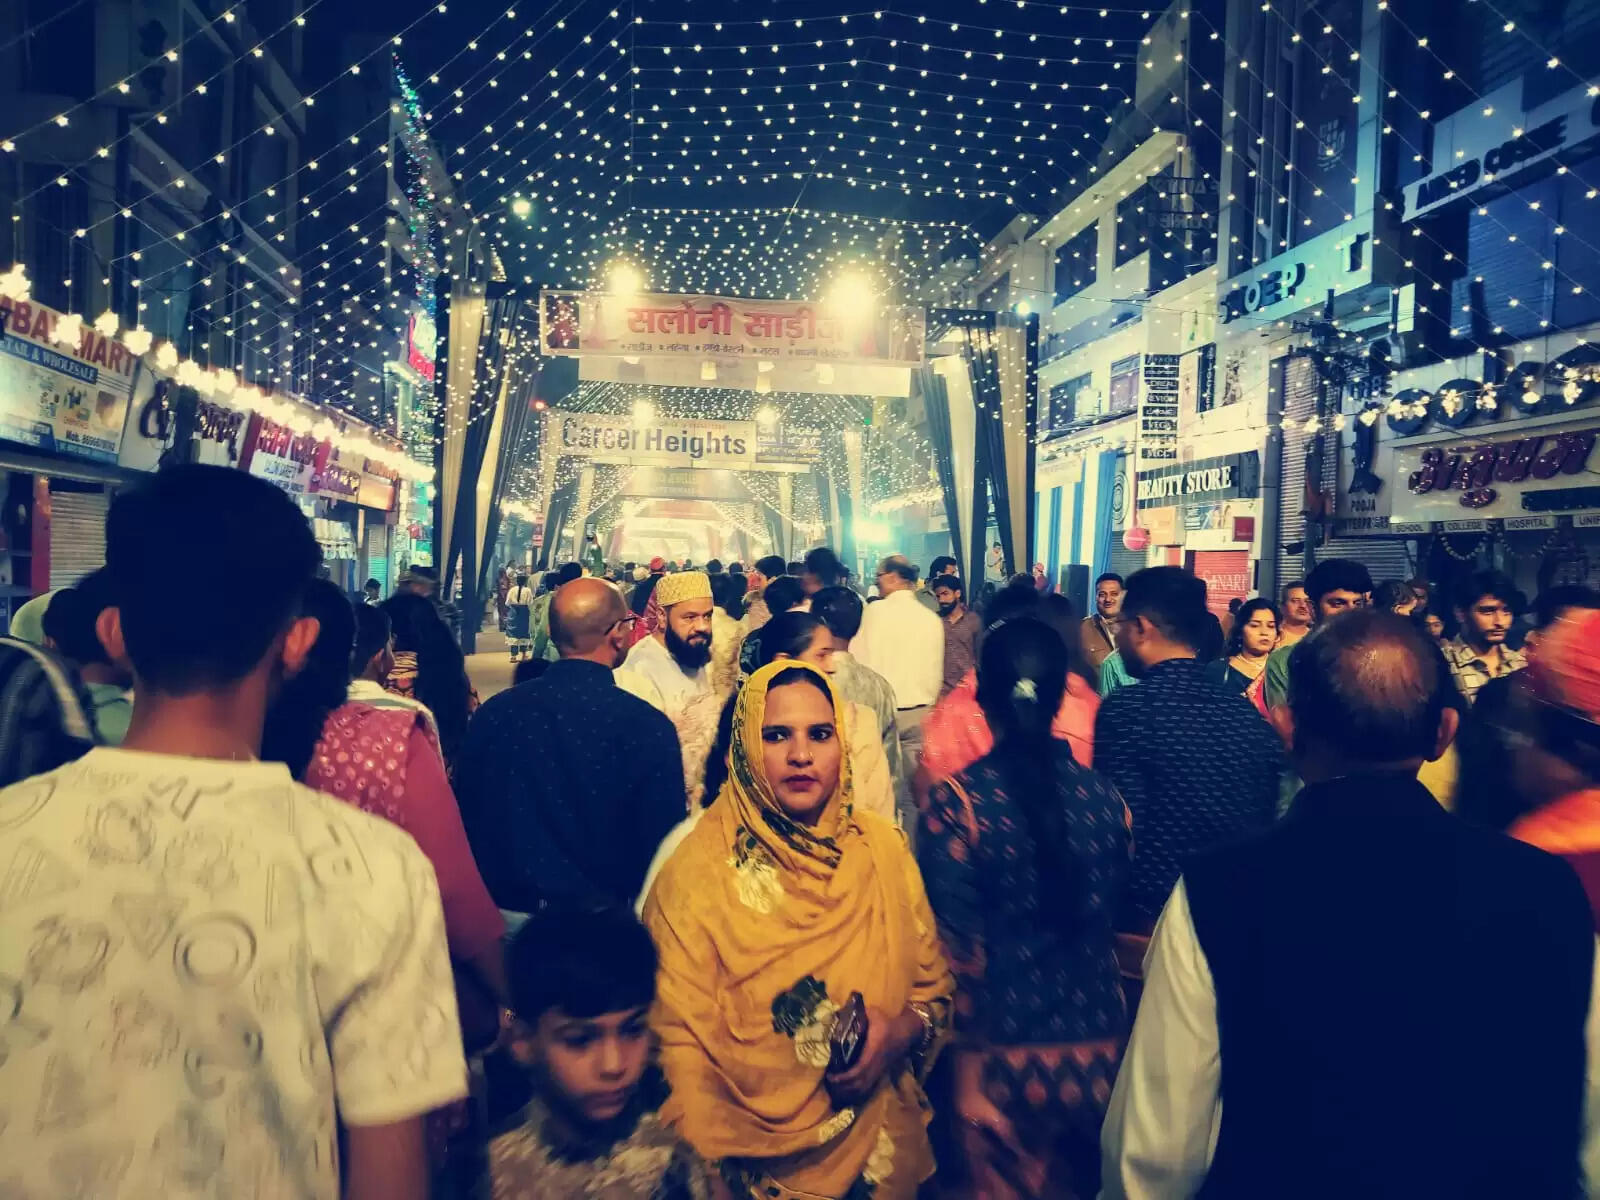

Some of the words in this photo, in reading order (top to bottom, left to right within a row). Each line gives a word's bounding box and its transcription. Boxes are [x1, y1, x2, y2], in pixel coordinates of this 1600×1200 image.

[627, 300, 733, 336] सलोनी
[43, 351, 96, 383] WHOLESALE
[563, 417, 639, 450] Career
[645, 428, 747, 459] Heights
[1138, 474, 1183, 500] BEAUTY
[1186, 465, 1231, 494] STORE
[1351, 499, 1375, 513] POOJA
[1395, 523, 1424, 533] SCHOOL
[1447, 520, 1483, 531] COLLEGE
[1507, 517, 1549, 529] HOSPITAL
